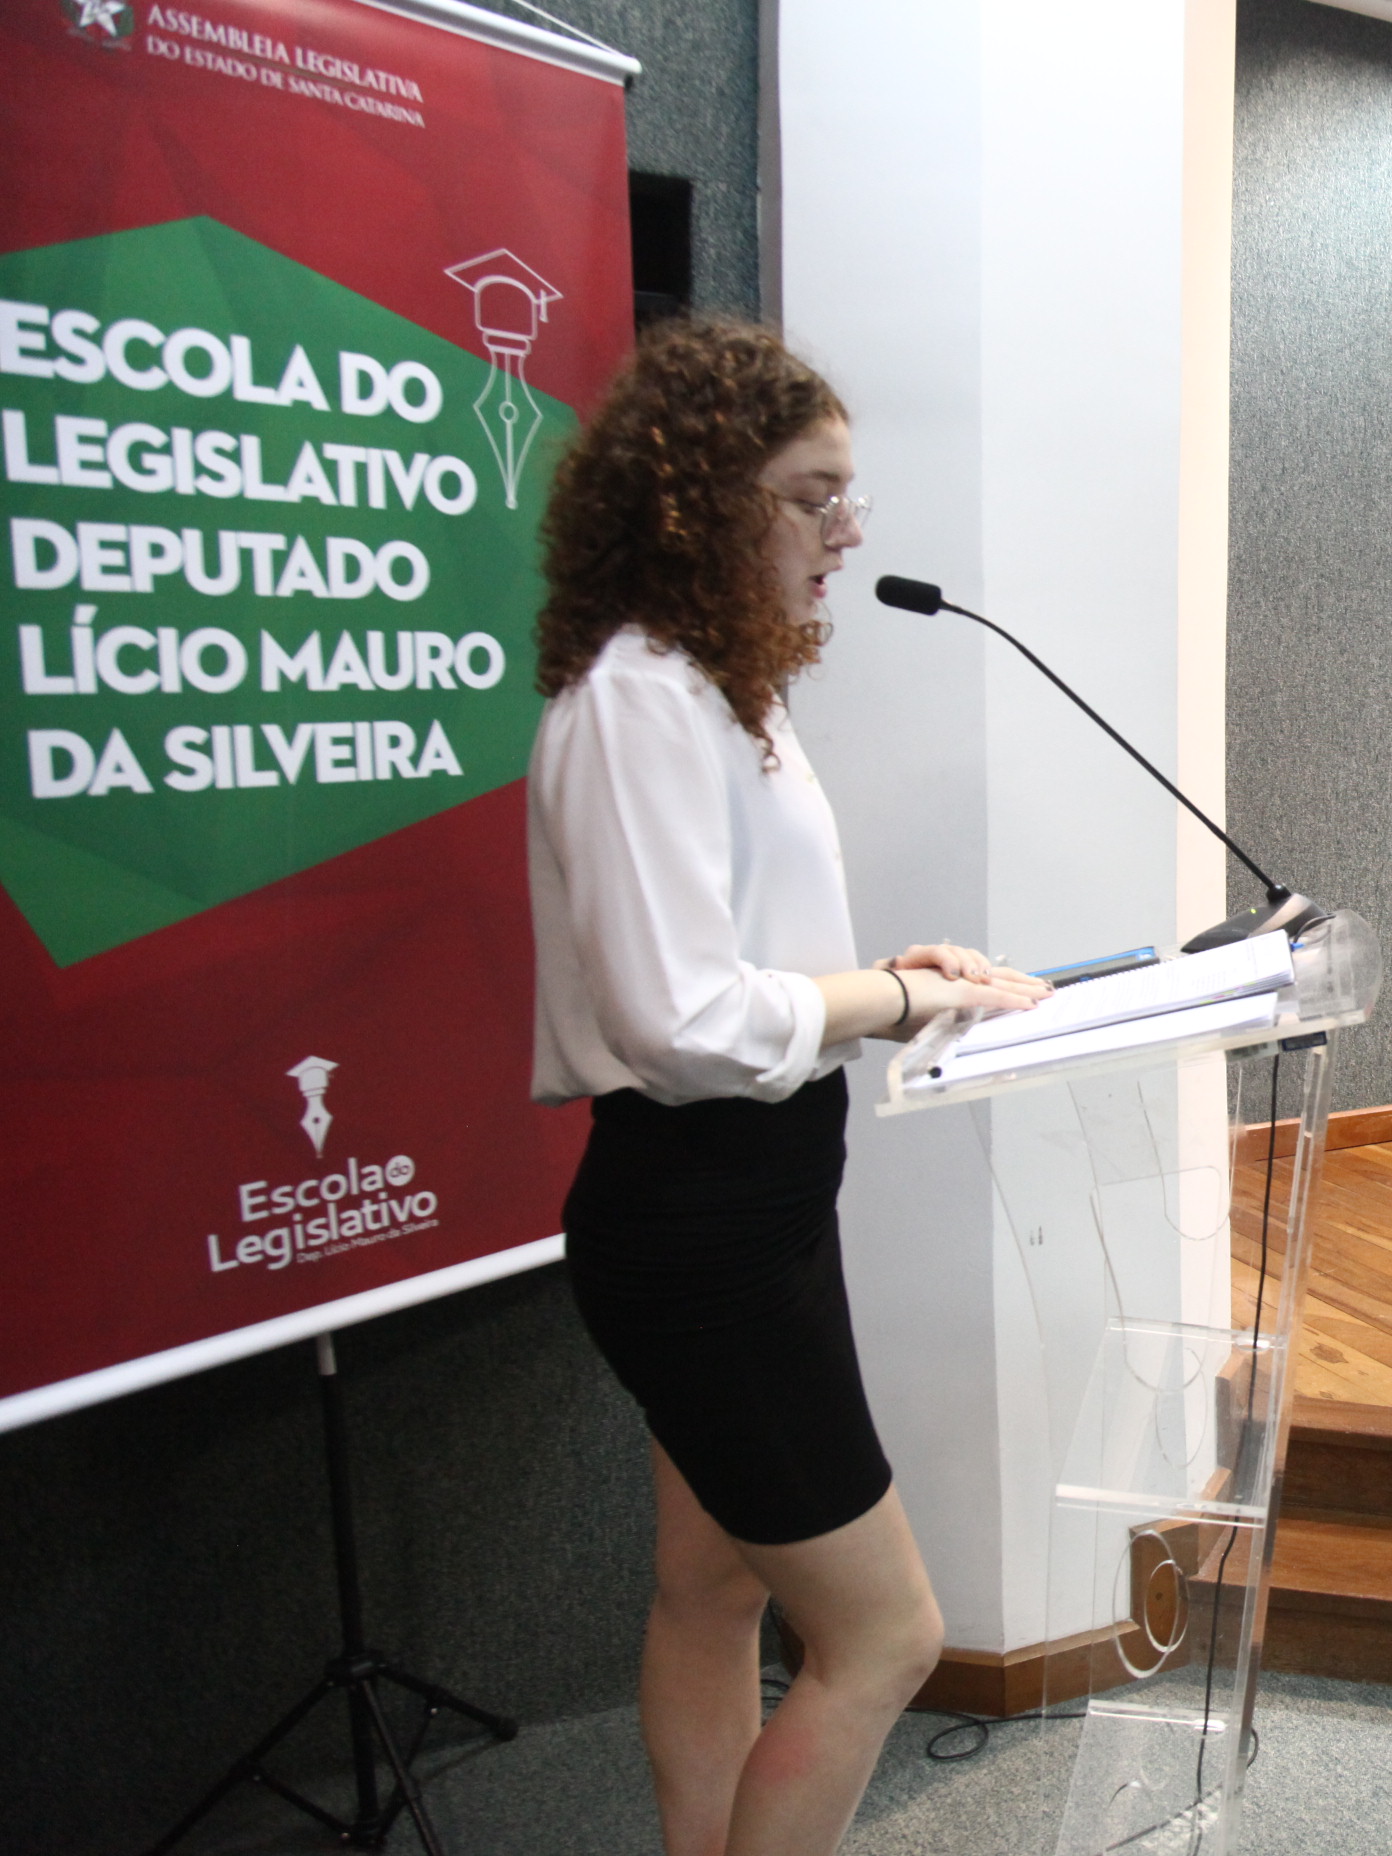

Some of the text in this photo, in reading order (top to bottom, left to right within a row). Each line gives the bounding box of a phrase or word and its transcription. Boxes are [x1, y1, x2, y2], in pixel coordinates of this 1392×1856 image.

[147, 35, 180, 61] DO
[184, 45, 258, 82] ESTADO
[260, 67, 284, 91] DE
[288, 76, 343, 106] SANTA
[343, 91, 426, 129] CATARINA
[148, 4, 291, 66] ASSEMBLEIA
[295, 47, 423, 103] LEGISLATIVA
[0, 300, 443, 423] ESCOLA DO
[2, 409, 477, 516] LEGISLATIVO
[10, 517, 430, 602] DEPUTADO
[19, 604, 506, 695] LÍCIO MAURO
[27, 718, 463, 799] DA SILVEIRA
[207, 1190, 438, 1272] Legislativo
[238, 1157, 384, 1223] Escola
[401, 1218, 440, 1235] Silveira
